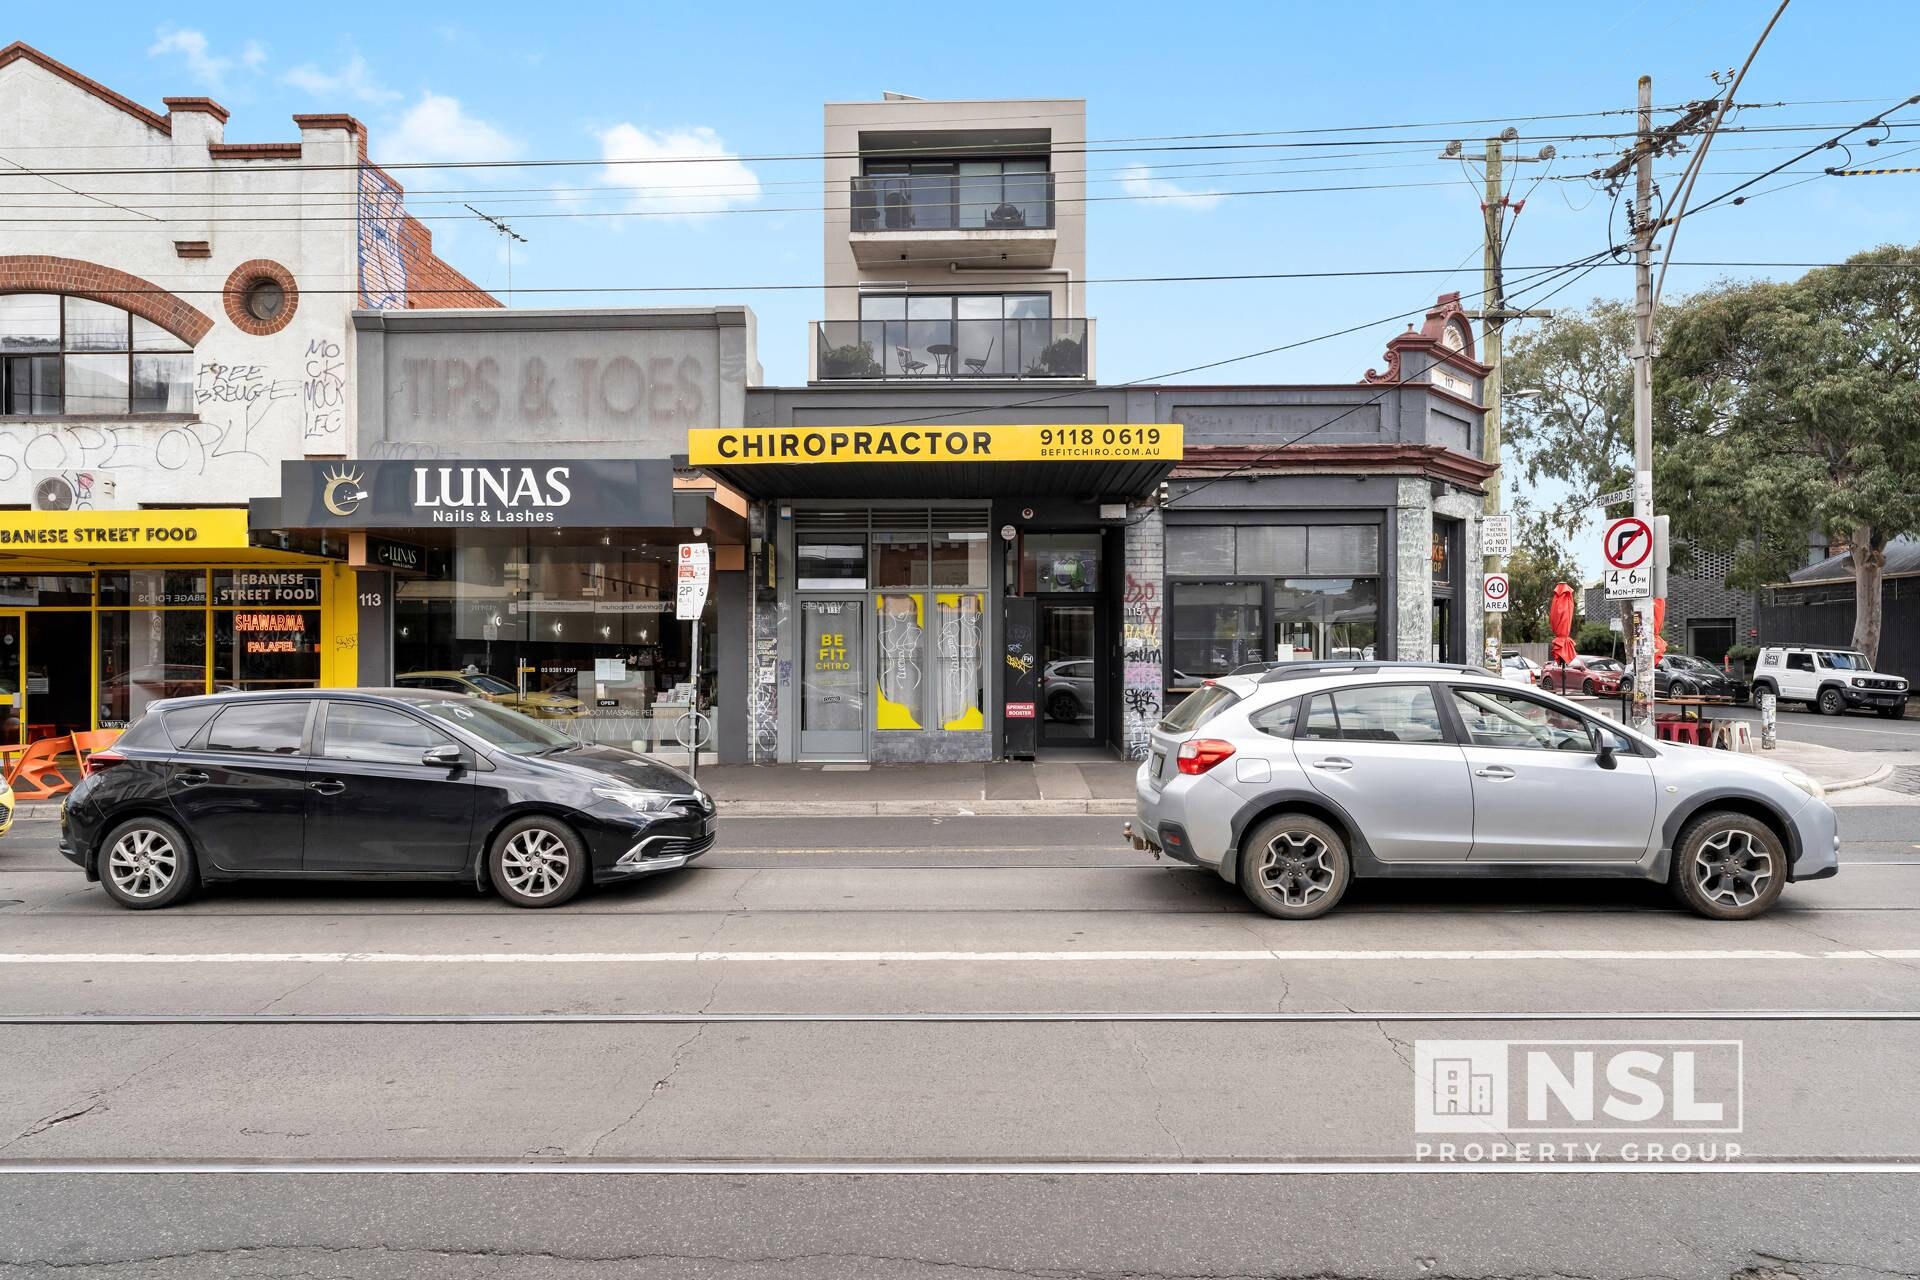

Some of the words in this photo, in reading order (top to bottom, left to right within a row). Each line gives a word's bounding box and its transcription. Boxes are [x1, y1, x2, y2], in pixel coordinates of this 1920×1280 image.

[402, 355, 500, 419] TIPS
[564, 355, 703, 421] TOES
[717, 431, 993, 459] CHIROPRACTOR
[1040, 429, 1094, 446] 9118
[1103, 428, 1161, 445] 0619
[1040, 448, 1161, 456] BEFITCHIRO.COM.AU
[414, 467, 571, 509] LUNAS
[1597, 491, 1623, 507] EDWARD
[1626, 488, 1634, 501] ST
[432, 510, 475, 523] Nails
[480, 510, 491, 523] &
[496, 510, 554, 523] Lashes
[73, 528, 140, 543] STREET
[145, 527, 198, 542] FOOD
[389, 546, 416, 564] LUNAS
[232, 573, 304, 585] LEBANESE
[1611, 570, 1618, 585] 4
[220, 589, 270, 600] STREET
[275, 589, 315, 600] FOOD
[679, 586, 692, 596] 2P
[1488, 582, 1504, 594] 40
[359, 593, 381, 607] 113
[1486, 602, 1508, 610] AREA
[1127, 608, 1143, 617] 115
[235, 614, 305, 631] SHAWARMA
[821, 633, 844, 647] BE
[247, 641, 297, 653] FALAFEL
[819, 648, 847, 661] FIT
[815, 662, 850, 670] CHIRO
[606, 708, 640, 717] MASSAGE
